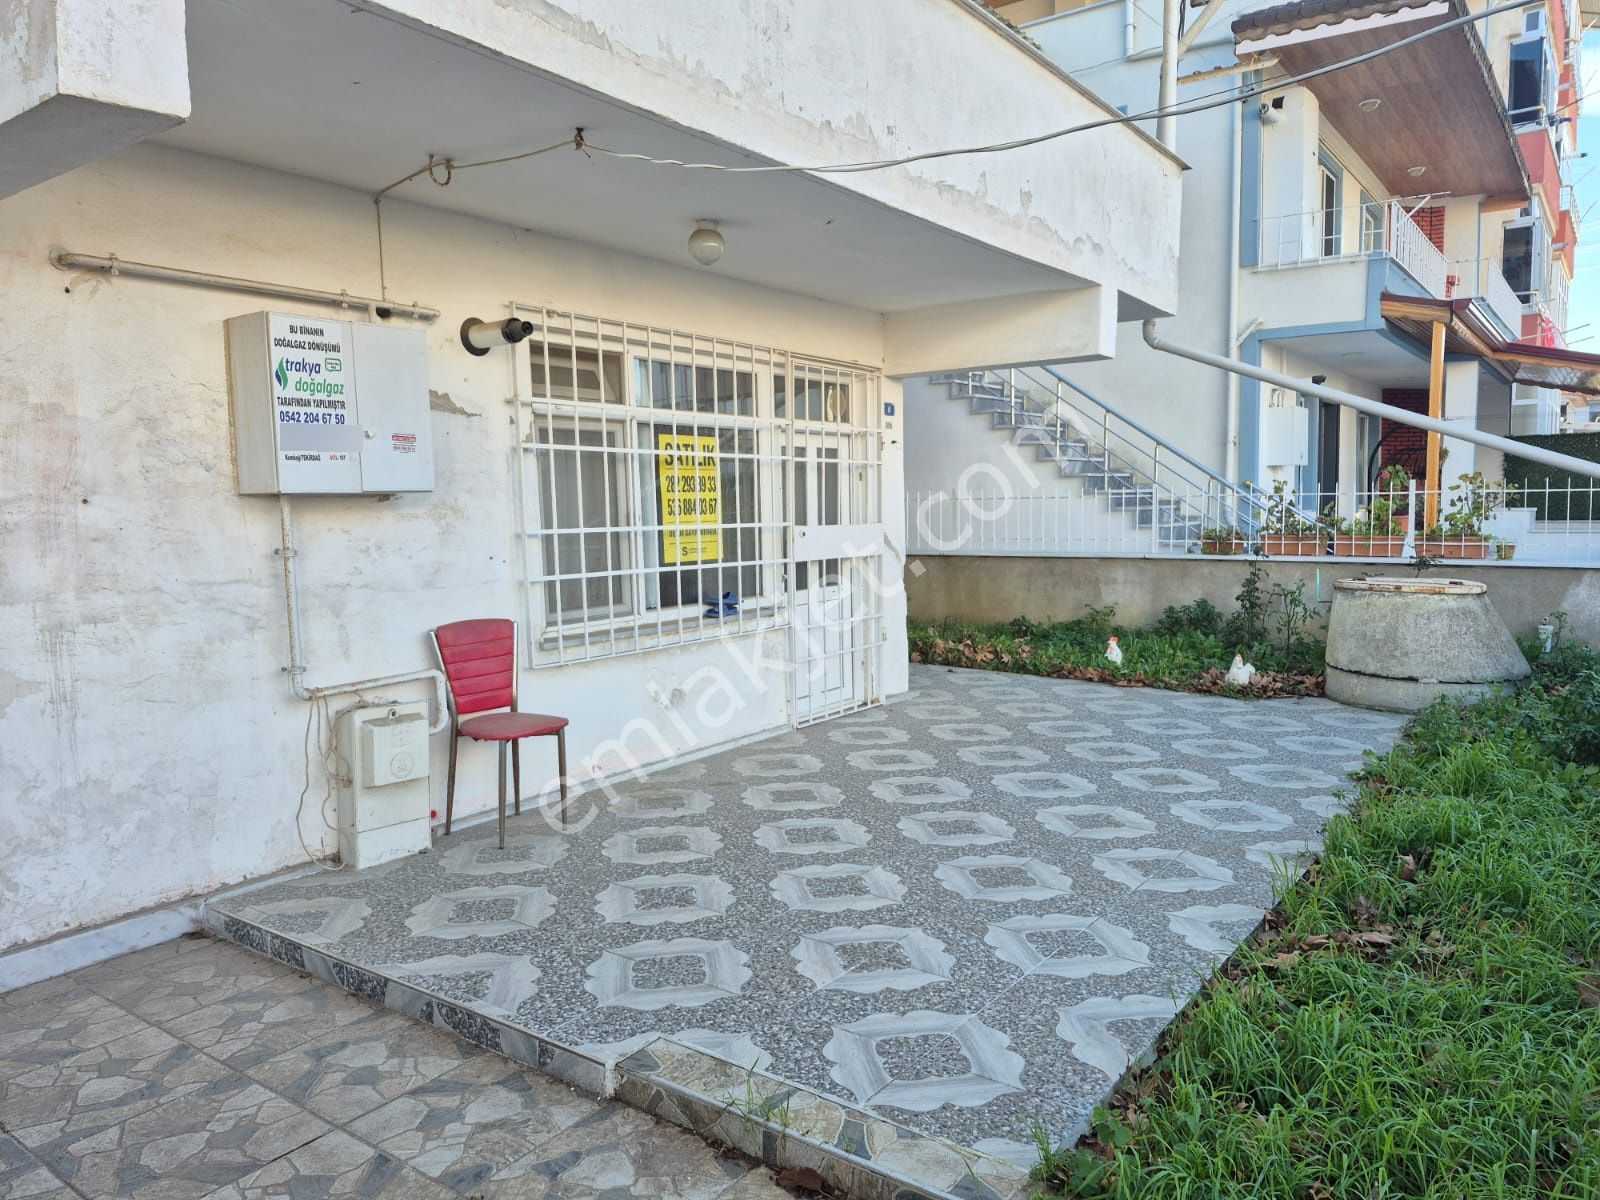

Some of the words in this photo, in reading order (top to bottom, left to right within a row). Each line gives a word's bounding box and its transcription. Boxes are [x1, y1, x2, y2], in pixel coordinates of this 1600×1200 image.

[289, 325, 298, 334] BU
[299, 324, 324, 337] BİNANIN
[274, 337, 306, 350] DOĞALGAZ
[307, 341, 341, 354] DÖNÜŞÜMÜ
[285, 357, 321, 377] trakya
[295, 377, 344, 397] doğalgaz
[277, 397, 312, 408] TARAFINDAN
[312, 399, 346, 411] YAPILMIŞTIR
[280, 411, 301, 423] 0542
[303, 412, 320, 424] 204
[322, 413, 332, 425] 67
[335, 414, 345, 425] 50
[665, 442, 716, 467] SATIIK
[682, 475, 696, 493] 293
[708, 475, 717, 493] 33
[709, 498, 717, 515] 67
